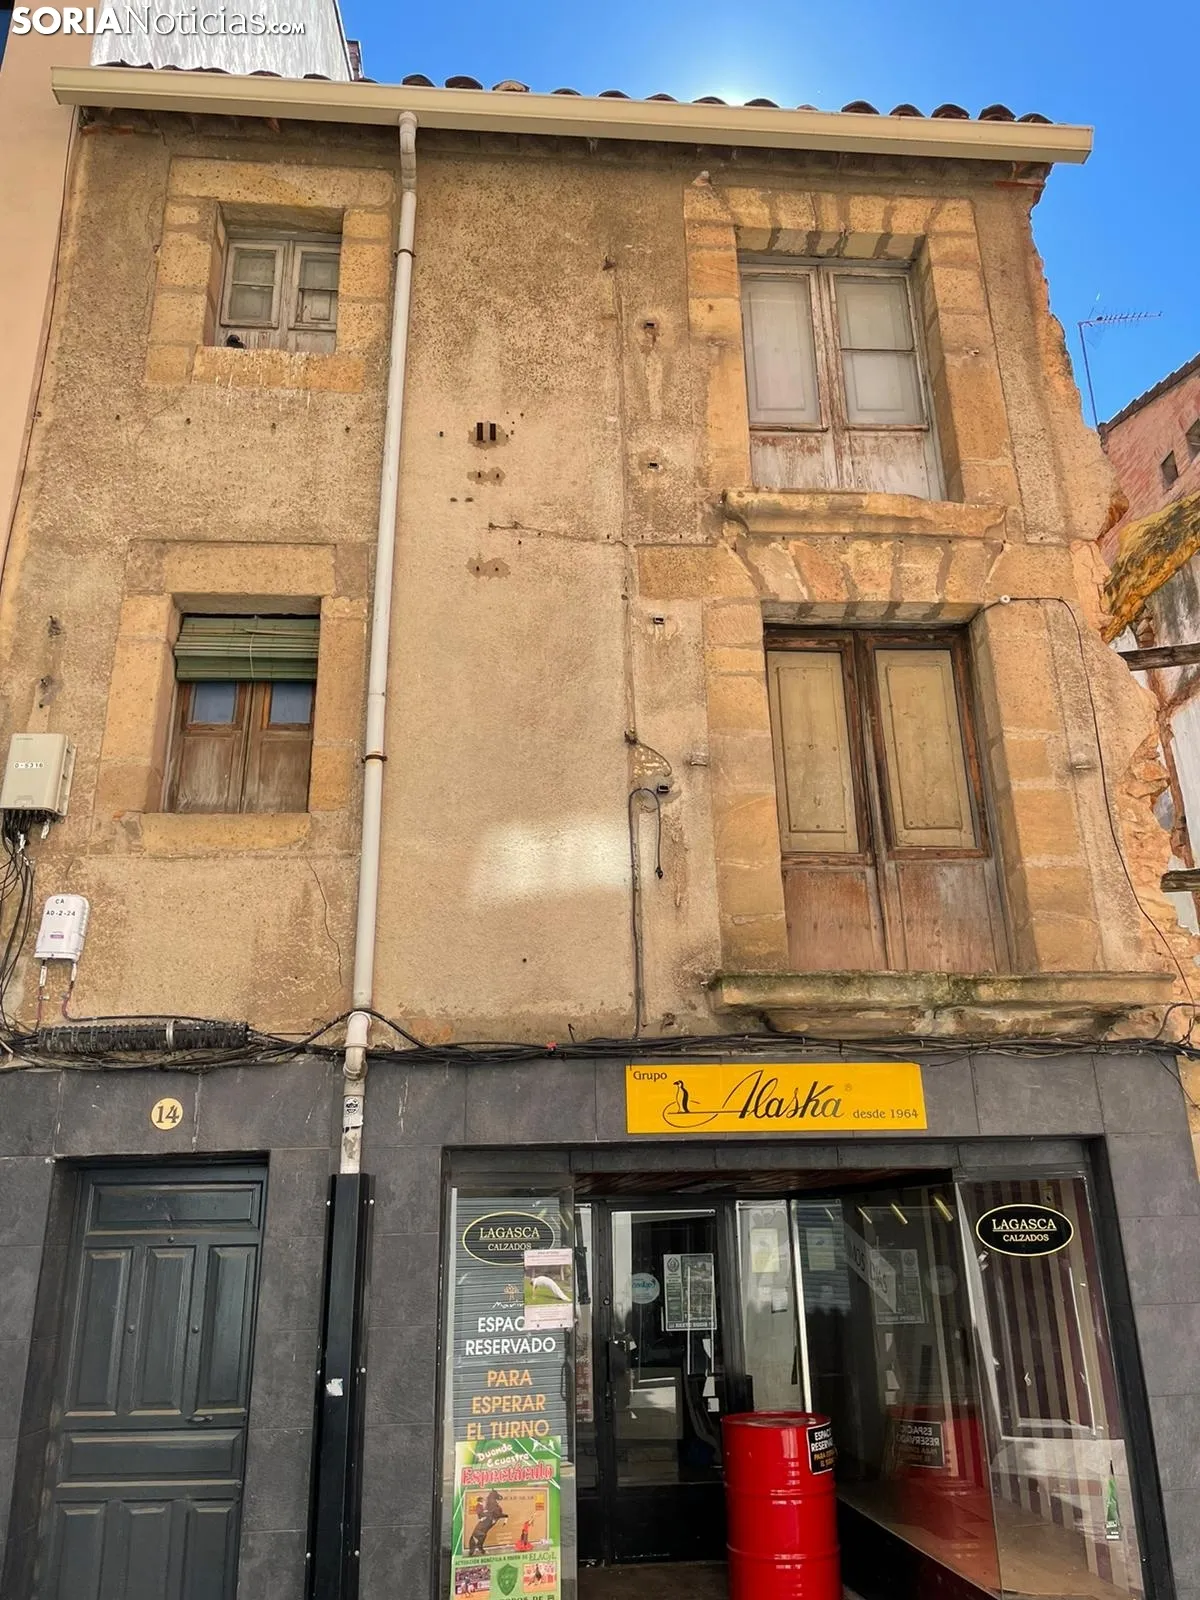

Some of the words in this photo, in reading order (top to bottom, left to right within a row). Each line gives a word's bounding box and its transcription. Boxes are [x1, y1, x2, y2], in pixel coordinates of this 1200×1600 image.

[633, 1071, 667, 1082] Grupo
[156, 1105, 180, 1123] 14
[853, 1109, 886, 1119] desde
[890, 1109, 918, 1119] 1964
[991, 1218, 1057, 1230] LAGASCA
[480, 1227, 540, 1239] LAGASCA
[1003, 1234, 1049, 1242] CALZADOS
[488, 1243, 532, 1251] CALZADOS
[478, 1316, 525, 1332] ESPAC
[465, 1337, 556, 1355] RESERVADO
[487, 1369, 533, 1387] PARA
[472, 1394, 546, 1414] ESPERAR
[467, 1422, 485, 1440] EL
[490, 1420, 550, 1439] TURNO
